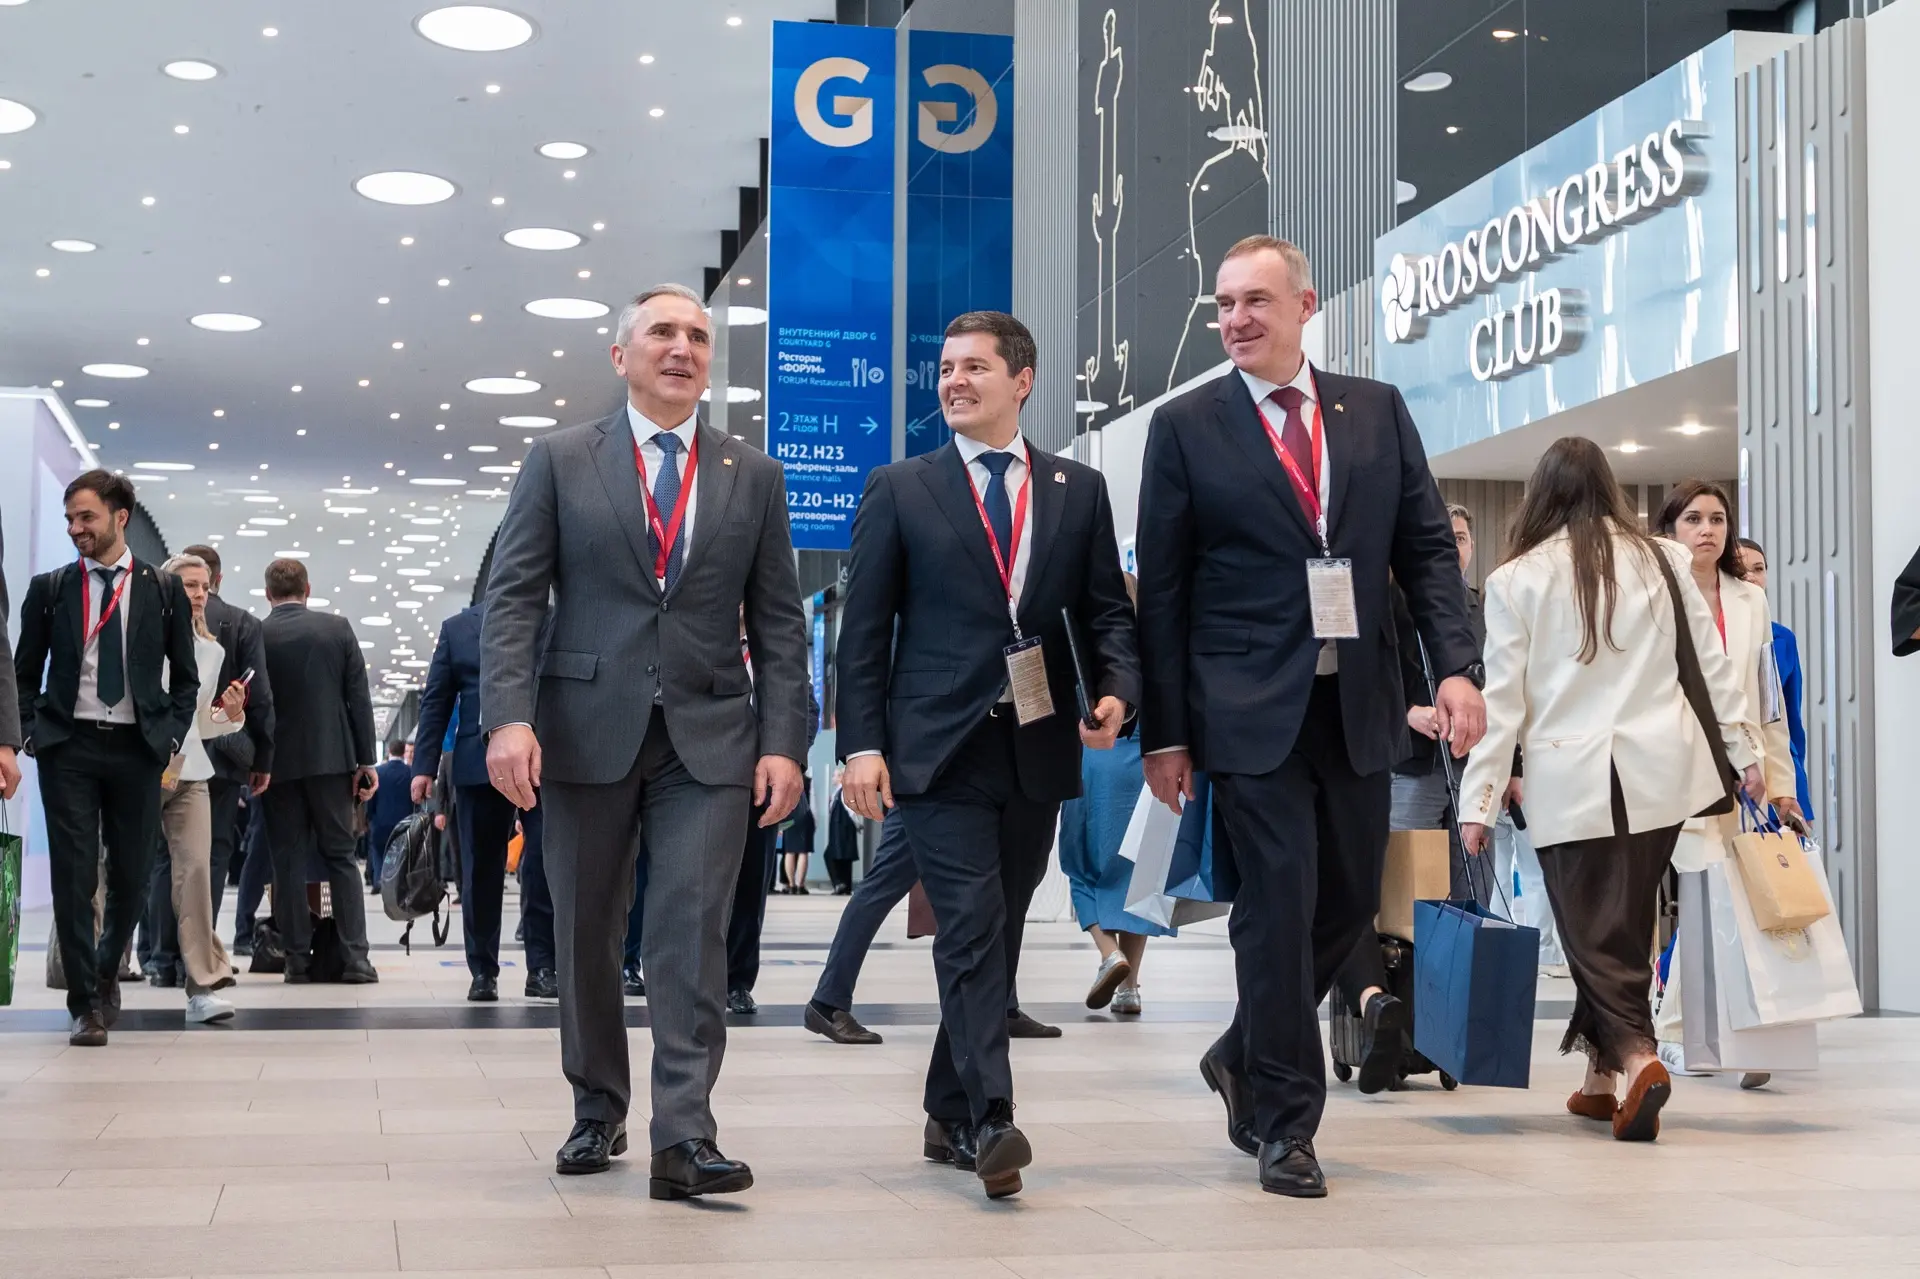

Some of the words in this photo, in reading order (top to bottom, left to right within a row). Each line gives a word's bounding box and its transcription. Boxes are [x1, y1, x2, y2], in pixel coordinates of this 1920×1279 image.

[794, 56, 873, 147] G
[1417, 119, 1686, 318] ROSCONGRESS
[779, 327, 840, 339] ВНУТРЕННИЙ
[842, 331, 868, 341] ДВОР
[869, 332, 877, 341] G
[1469, 287, 1565, 382] CLUB
[778, 338, 823, 348] COURTYARD
[825, 340, 832, 348] G
[778, 351, 822, 363] Ресторан
[778, 362, 826, 374] «ФОРУМ»
[778, 375, 808, 385] FORUM
[809, 377, 852, 388] Restaurant
[778, 411, 790, 432] 2
[793, 414, 819, 424] ЭТАЖ
[823, 414, 838, 434] H
[793, 424, 819, 433] FLOOR
[782, 461, 858, 473] онференц-залы
[783, 472, 821, 482] onference
[822, 474, 842, 483] halls
[788, 511, 847, 522] реговорные
[790, 522, 809, 532] ting
[810, 523, 835, 531] rooms
